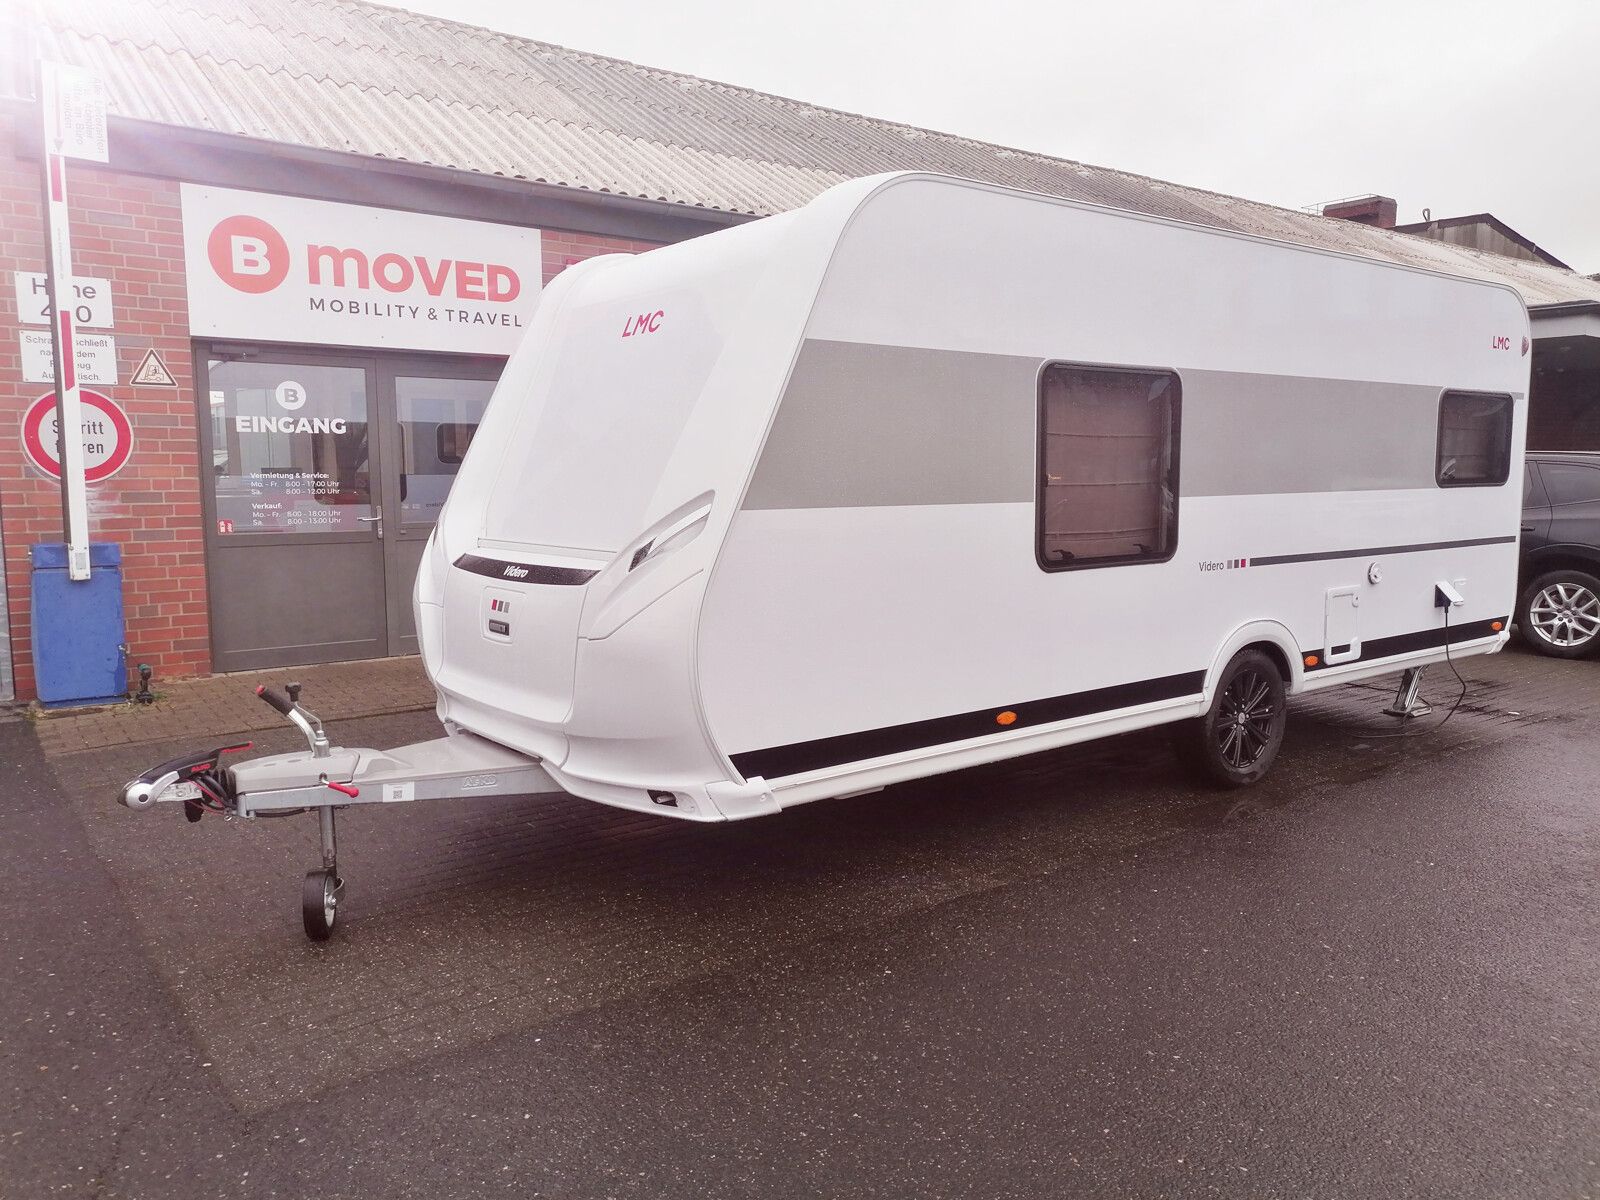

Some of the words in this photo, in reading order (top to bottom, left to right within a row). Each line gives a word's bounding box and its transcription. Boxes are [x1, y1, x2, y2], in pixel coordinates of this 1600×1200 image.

[230, 234, 271, 275] B
[309, 297, 419, 319] MOBILITY
[427, 307, 438, 320] &
[445, 309, 522, 327] TRAVEL
[622, 310, 664, 337] LMC
[1492, 336, 1510, 350] LMC
[52, 420, 104, 435] Sritt
[235, 415, 347, 434] EINGANG
[250, 472, 294, 480] Vermietung
[503, 565, 529, 578] Videro
[1198, 561, 1225, 571] Videro
